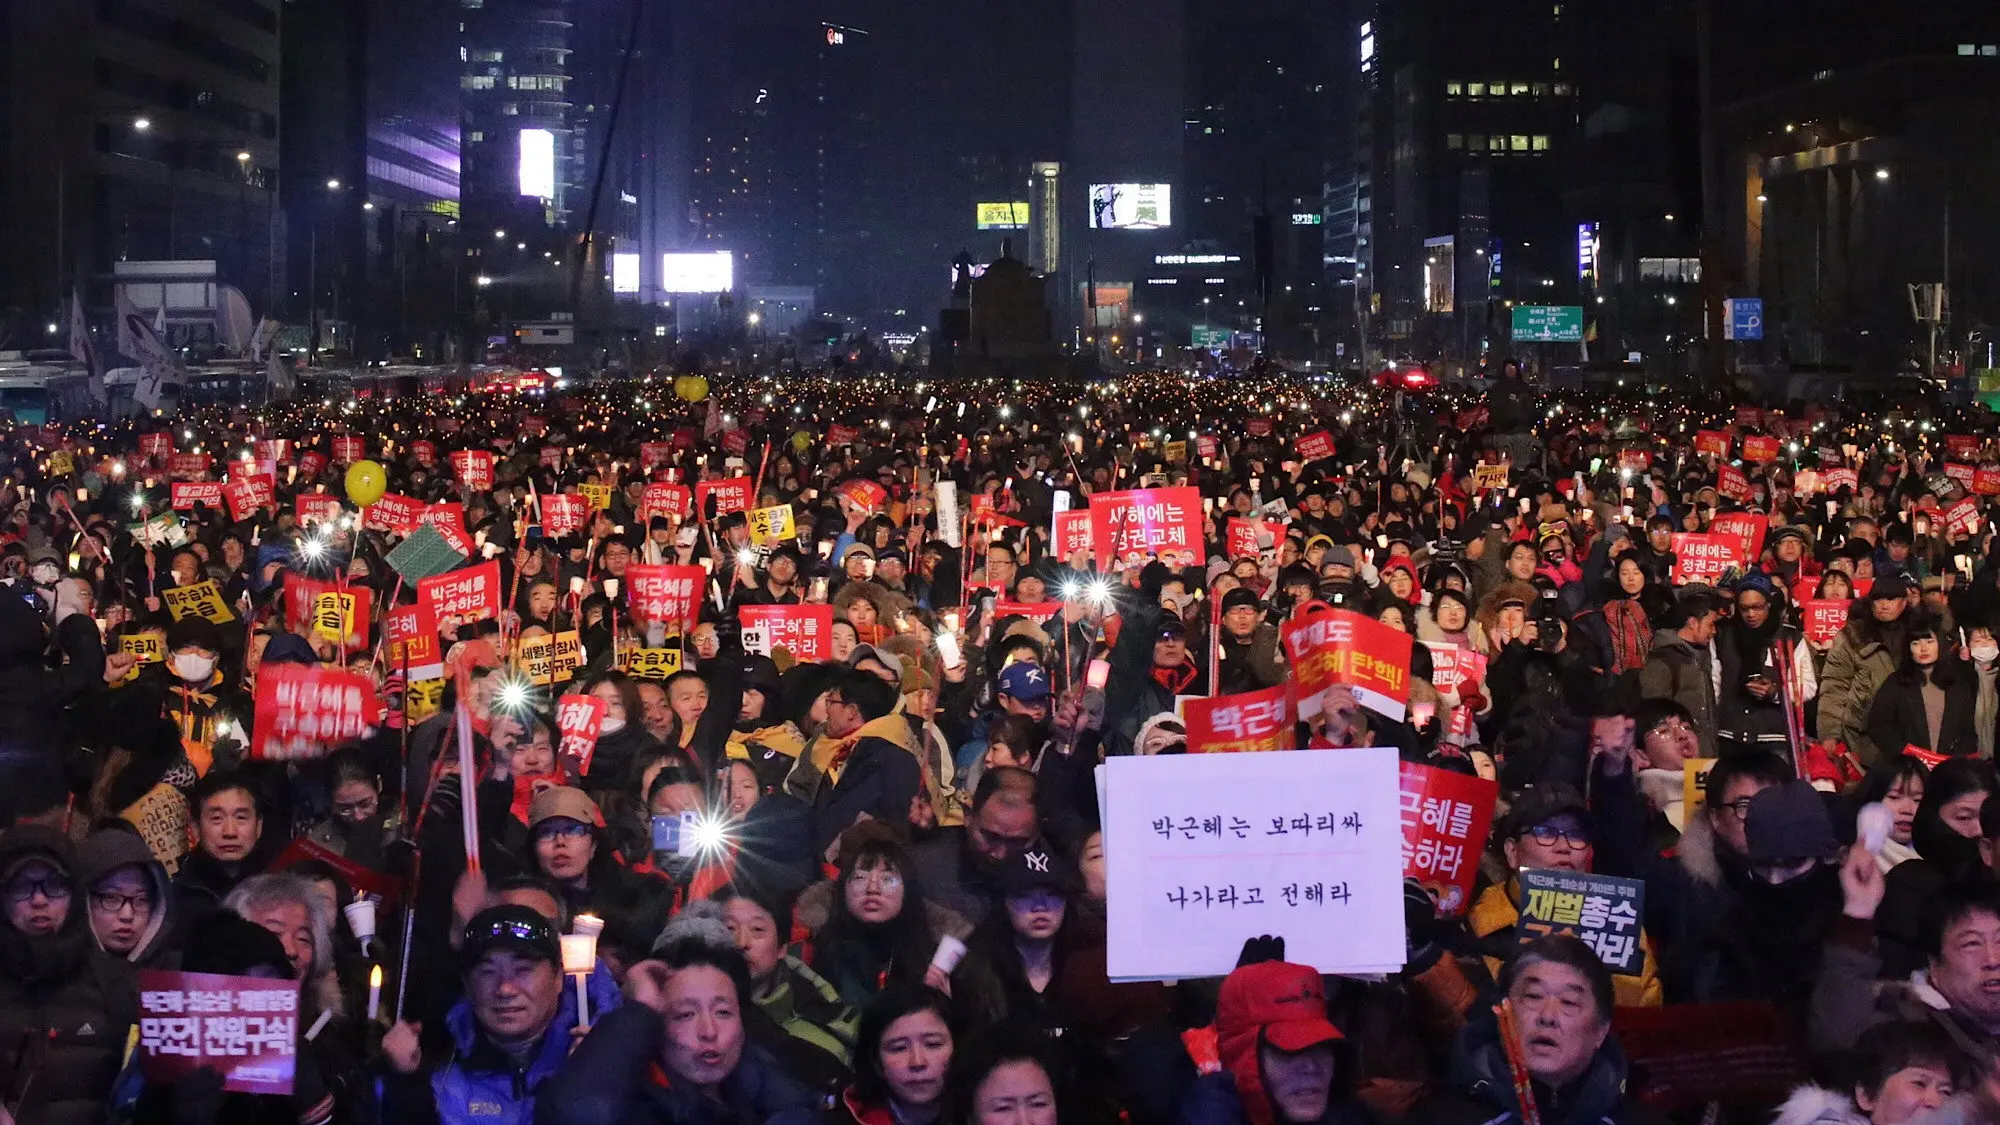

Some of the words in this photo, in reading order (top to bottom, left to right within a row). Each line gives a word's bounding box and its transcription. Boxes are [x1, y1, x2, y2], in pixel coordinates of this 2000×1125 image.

[1108, 503, 1185, 525] 새해에는
[1111, 525, 1187, 552] 정권교체
[1683, 543, 1732, 558] 새해에는
[166, 585, 214, 606] 미수습자
[430, 575, 486, 601] 박근혜를
[635, 578, 694, 598] 박근혜를
[434, 592, 486, 619] 구속하라
[522, 638, 579, 660] 세월호참사
[617, 652, 676, 667] 미수습자
[529, 656, 577, 676] 진상규명
[1351, 651, 1404, 691] 탄핵!
[1152, 815, 1251, 840] 박근혜는
[1266, 812, 1363, 837] 보따리싸
[1024, 851, 1049, 873] NY
[1166, 884, 1265, 910] 나가라고
[1280, 881, 1352, 907] 전해라
[1522, 888, 1638, 932] 재벌총수
[141, 1017, 201, 1057] 무조건
